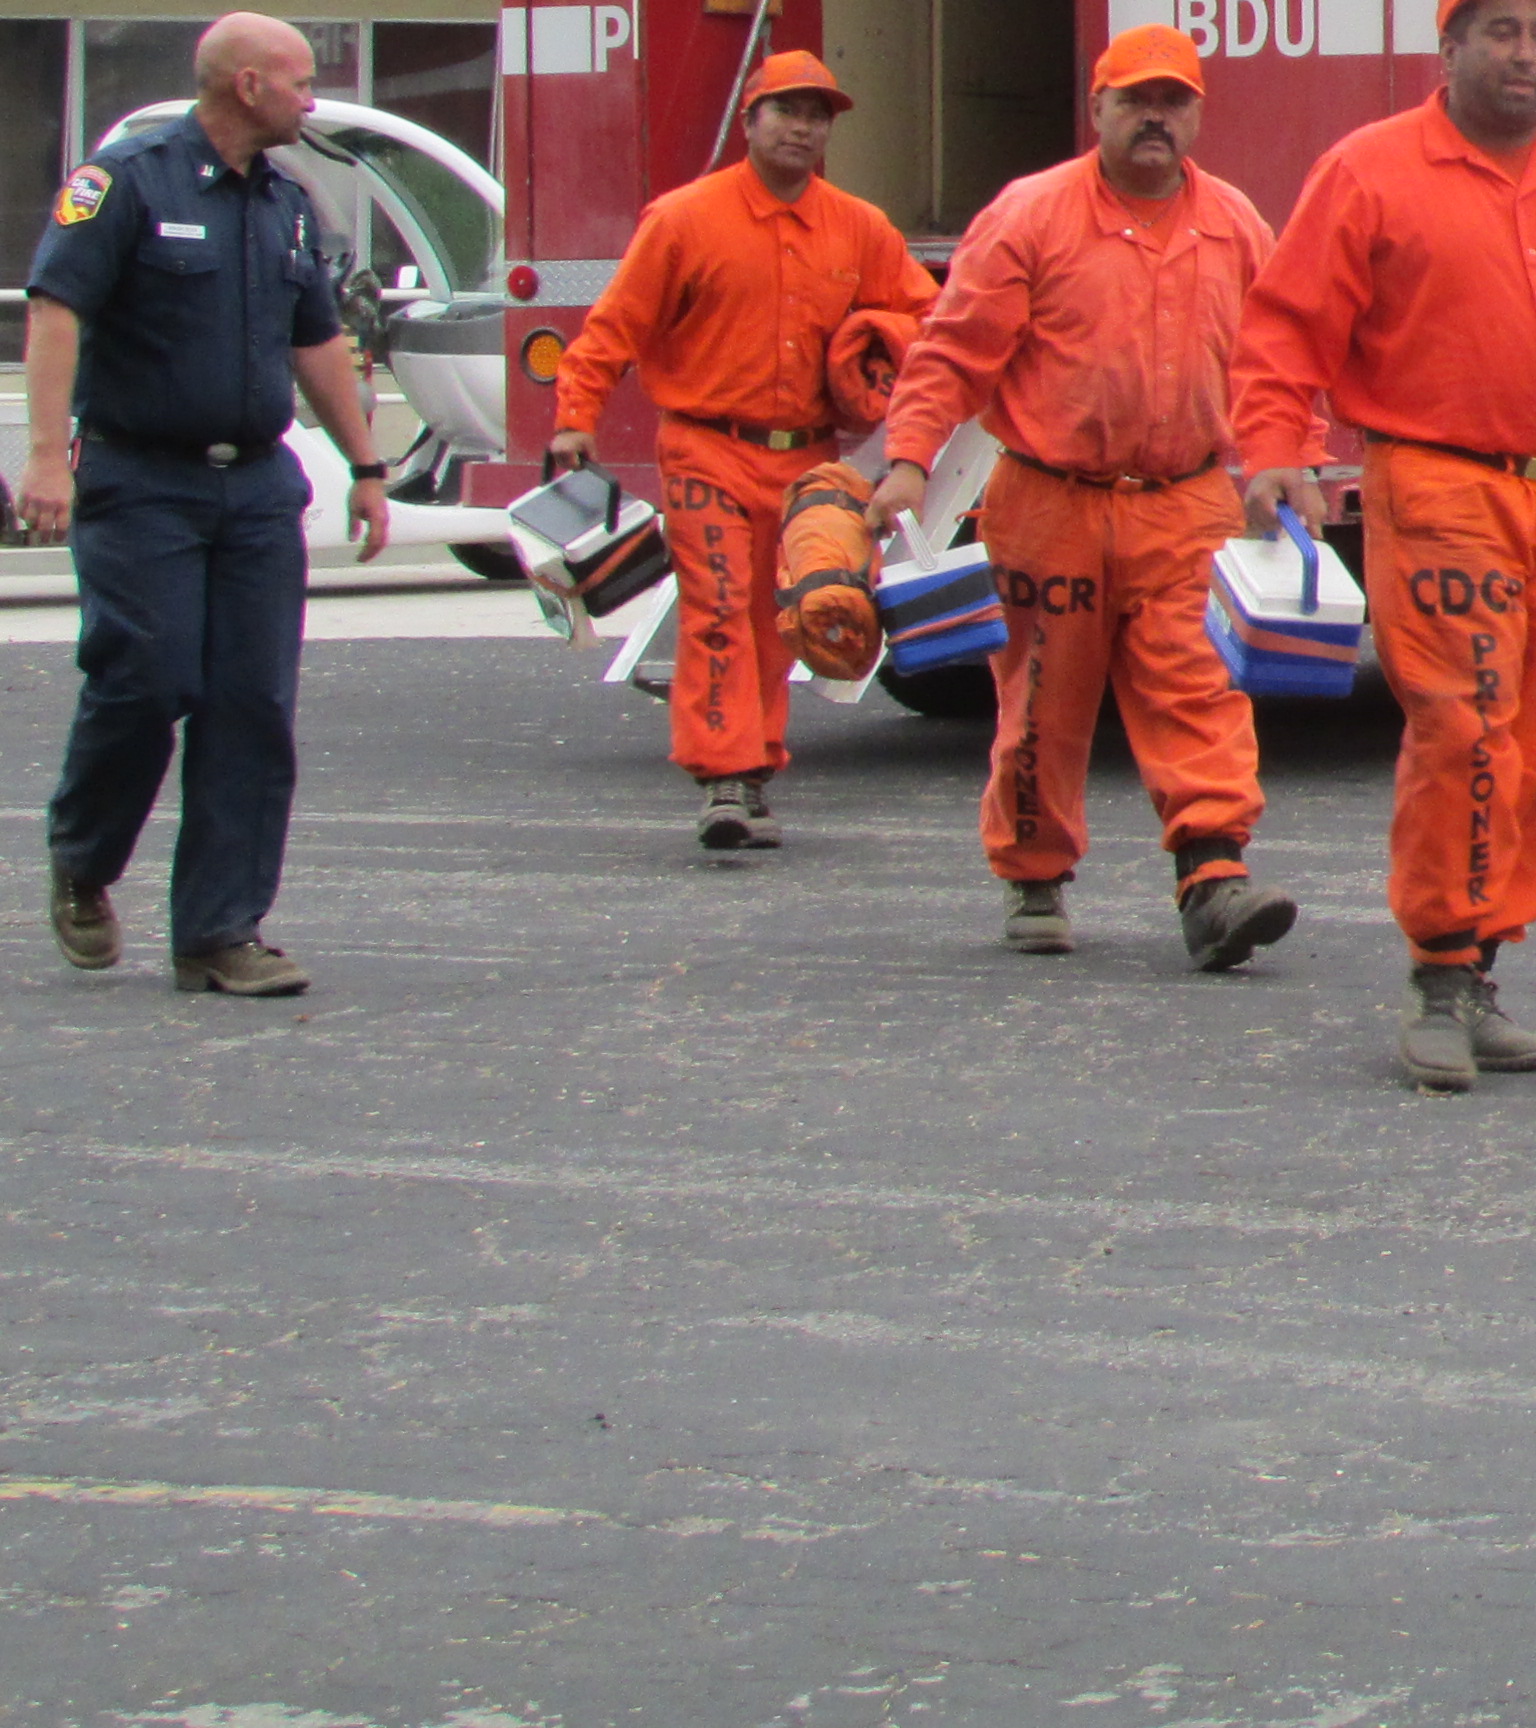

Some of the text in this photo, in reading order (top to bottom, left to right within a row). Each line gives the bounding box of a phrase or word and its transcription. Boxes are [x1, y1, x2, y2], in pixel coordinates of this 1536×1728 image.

[71, 177, 91, 189] CAL
[74, 186, 103, 201] FIRE
[1467, 632, 1501, 907] PRISONER
